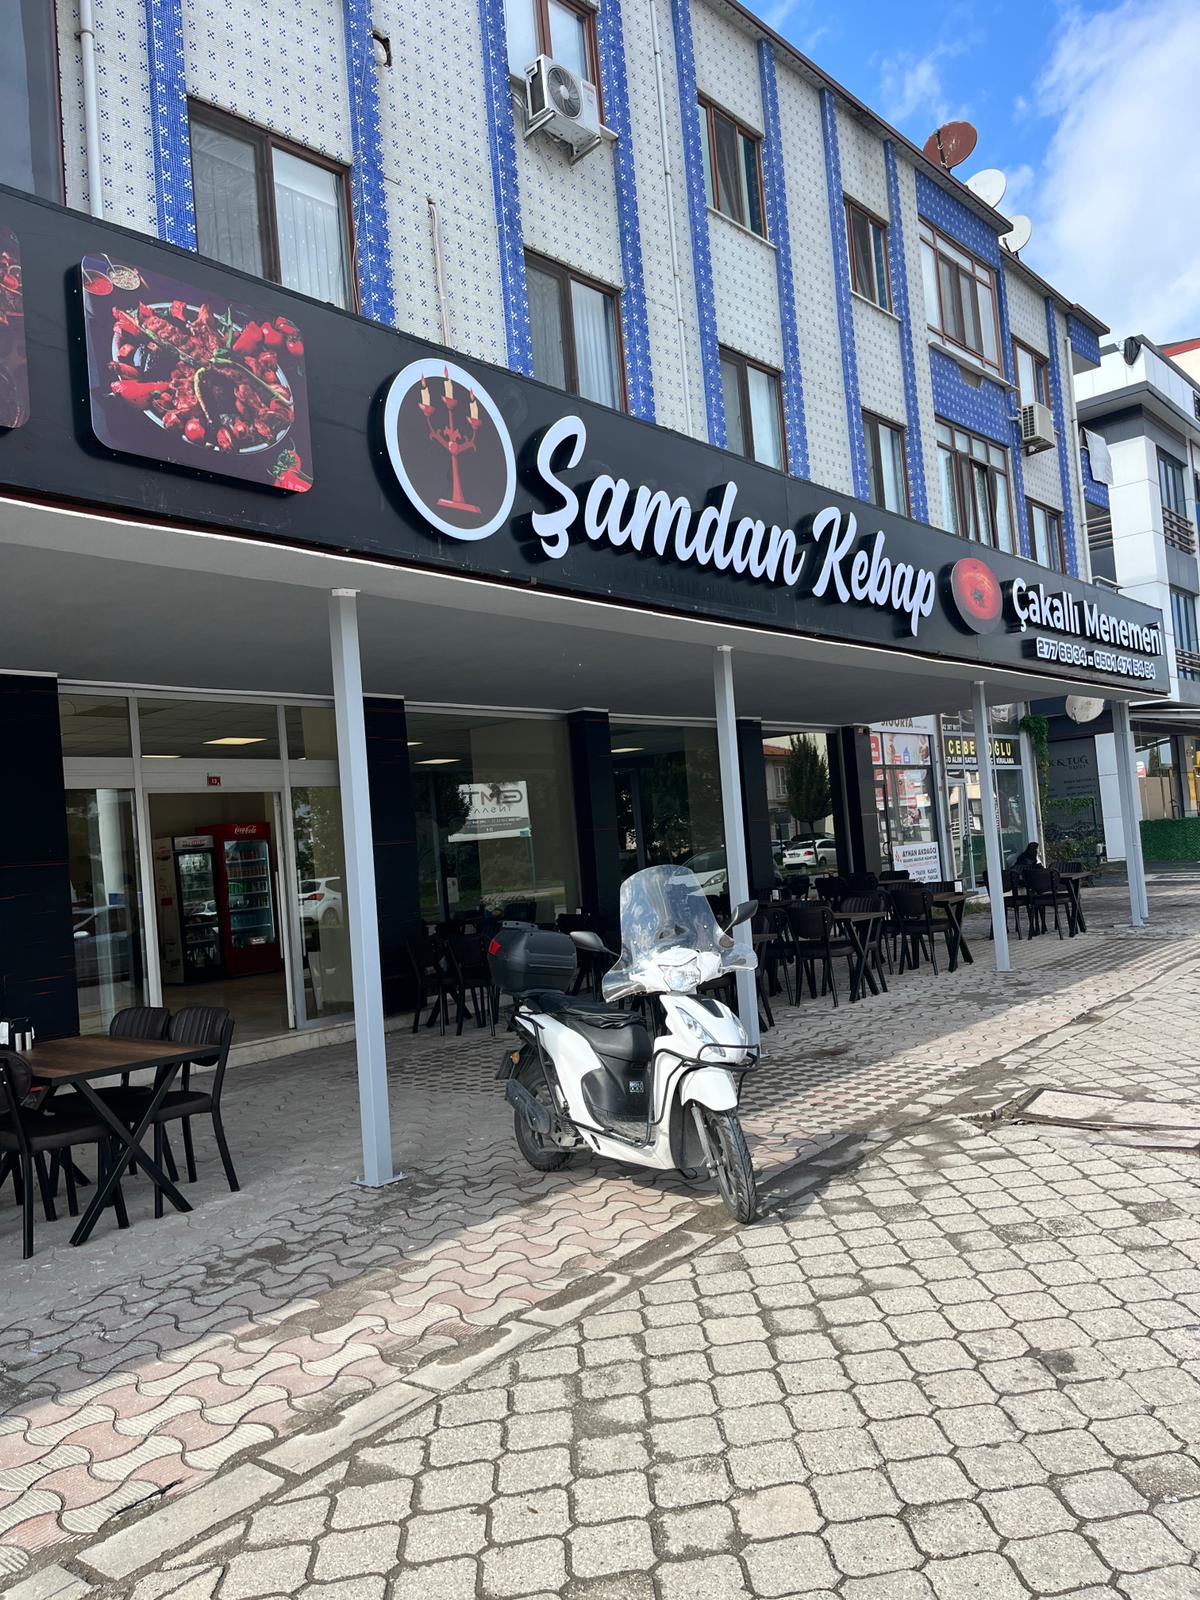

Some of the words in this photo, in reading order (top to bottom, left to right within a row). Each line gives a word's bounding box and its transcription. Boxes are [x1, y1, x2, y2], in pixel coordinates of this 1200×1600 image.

[532, 415, 806, 586] Şamdan
[812, 506, 936, 637] Kebap
[1012, 577, 1081, 635] Çakallı
[1083, 600, 1164, 656] Menemeni
[1036, 636, 1059, 661] 277
[1059, 642, 1074, 664] 66
[1073, 646, 1087, 667] 34
[1093, 650, 1118, 673] 0501
[1117, 656, 1133, 677] 471
[1133, 661, 1145, 679] 54
[1144, 663, 1156, 680] 54
